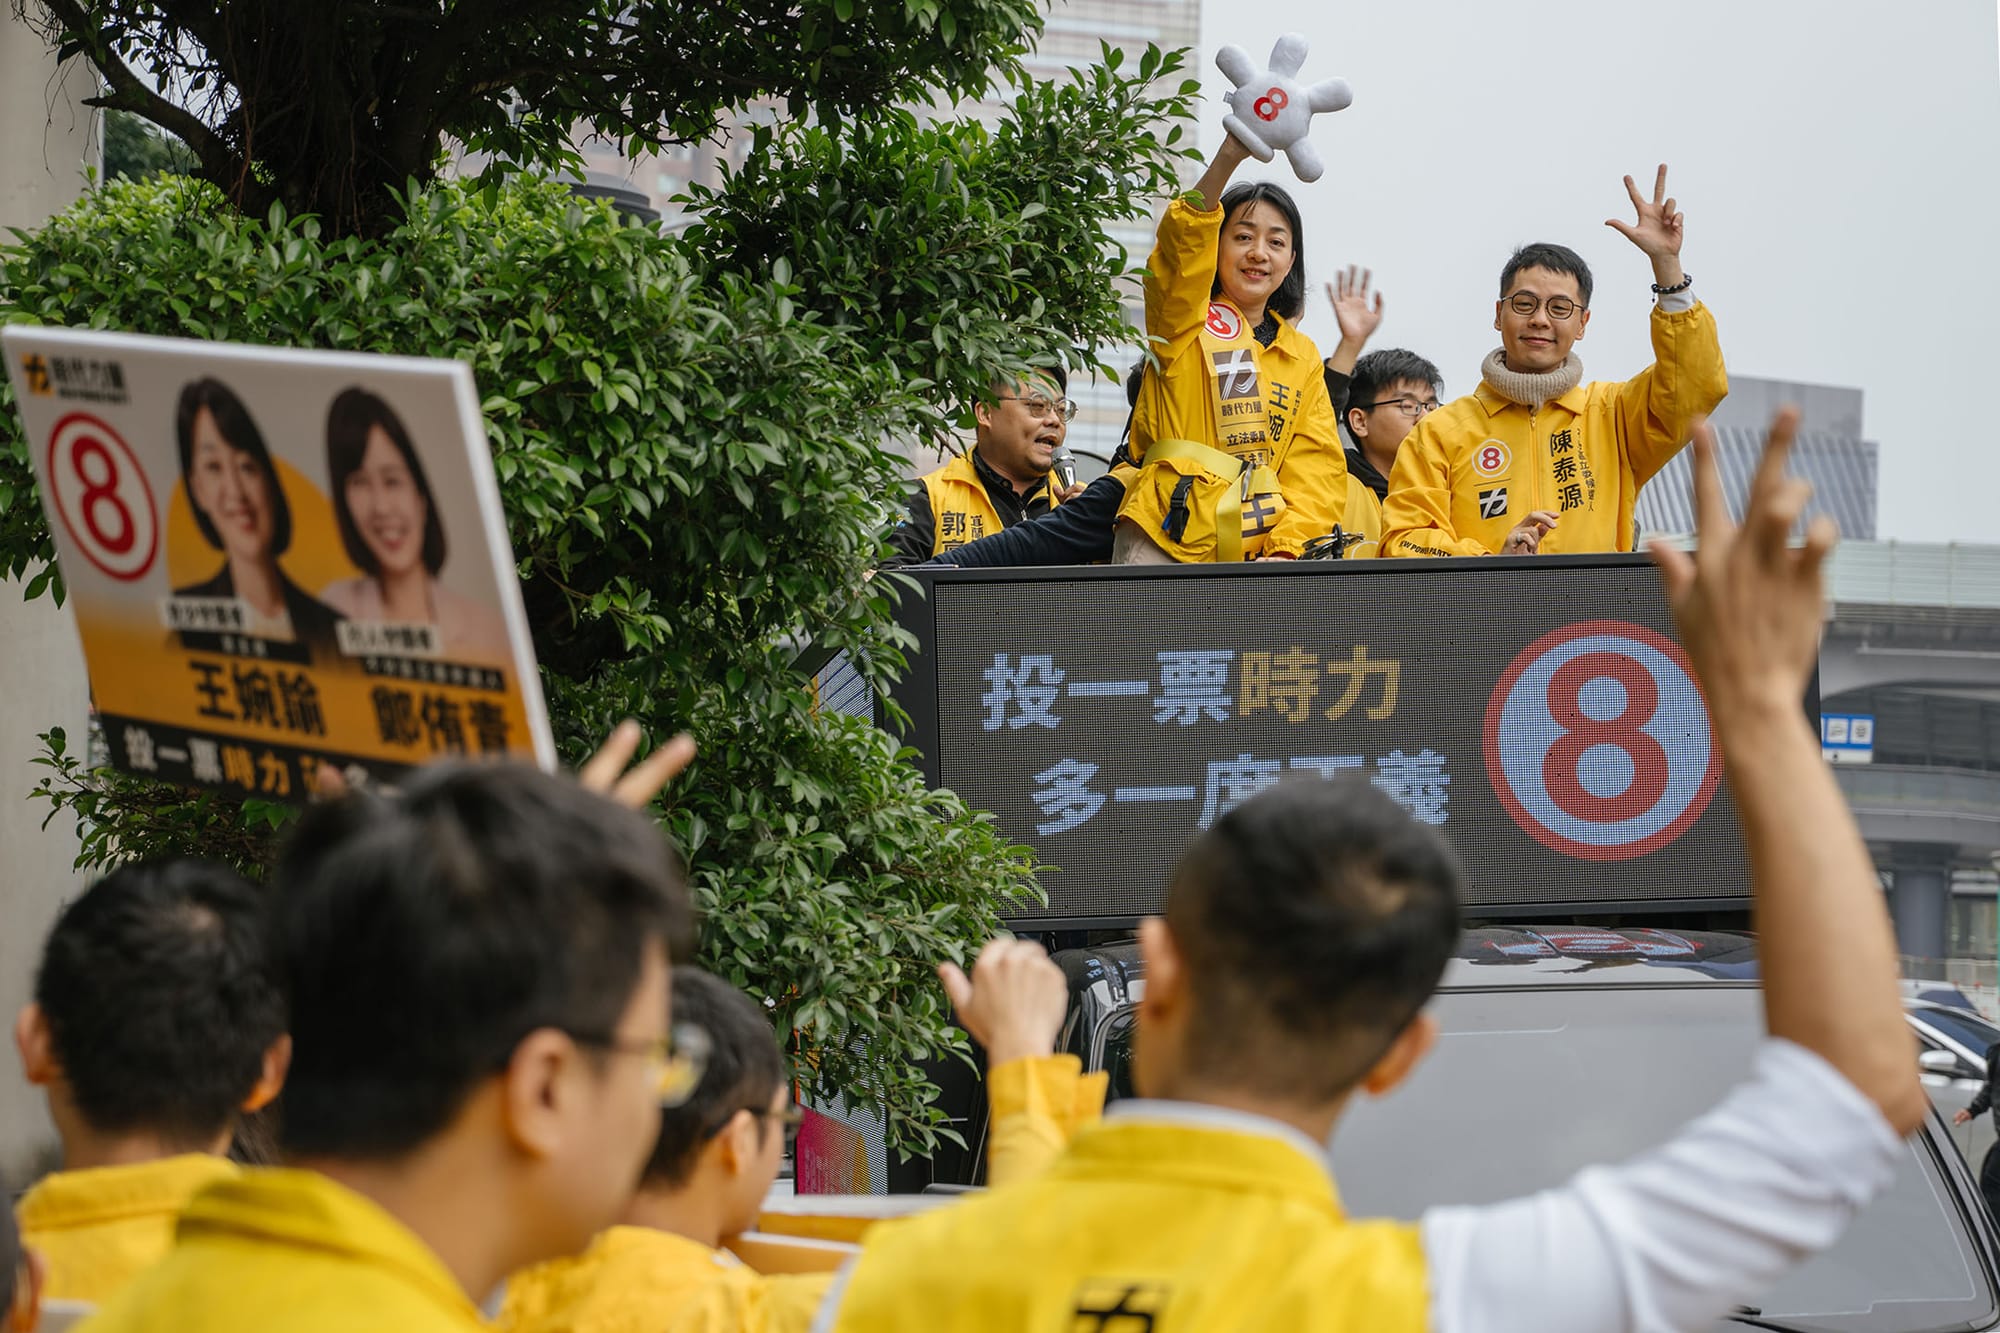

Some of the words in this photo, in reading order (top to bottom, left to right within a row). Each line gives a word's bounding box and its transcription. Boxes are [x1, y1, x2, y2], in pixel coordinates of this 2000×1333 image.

[1253, 87, 1289, 121] 8
[1221, 401, 1263, 417] 時代力量
[1226, 431, 1266, 447] 立法委員
[1482, 447, 1501, 470] 8
[70, 435, 136, 555] 8
[1550, 430, 1585, 512] 陳泰源
[982, 645, 1403, 732] 投一票時力
[1542, 651, 1670, 824] 8
